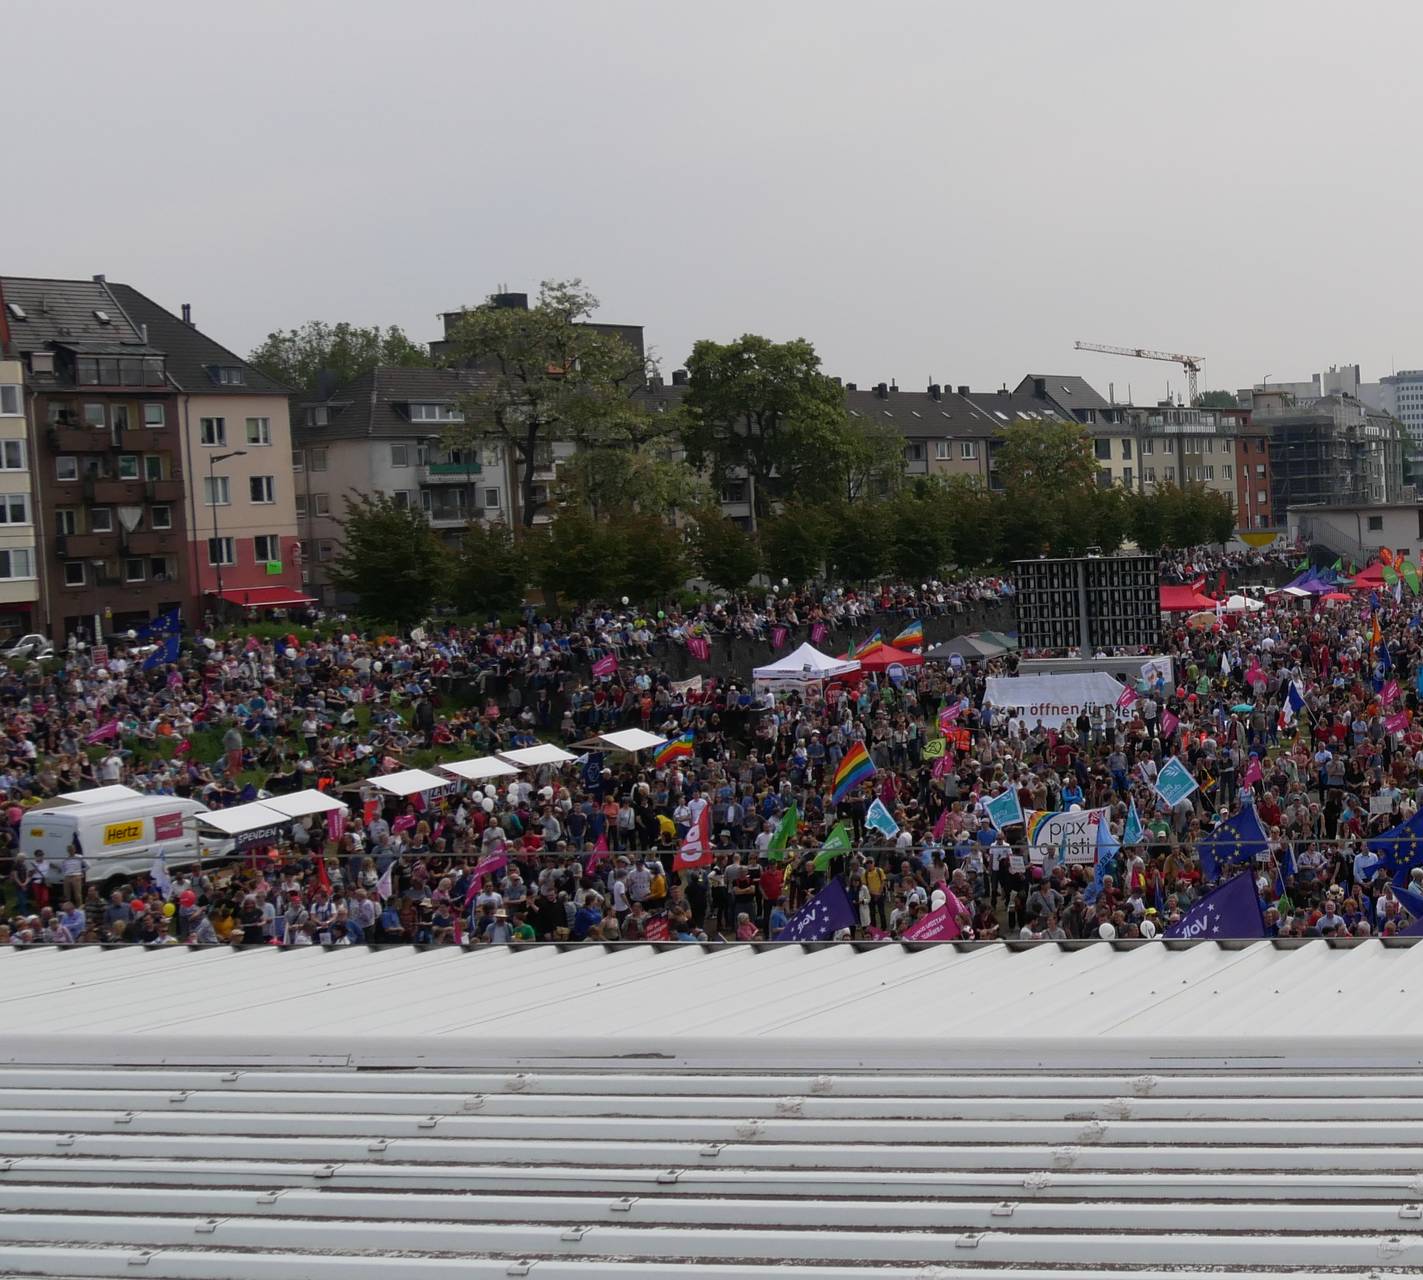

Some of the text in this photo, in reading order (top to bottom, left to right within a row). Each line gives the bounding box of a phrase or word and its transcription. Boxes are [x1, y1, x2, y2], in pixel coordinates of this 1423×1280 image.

[1029, 702, 1080, 716] öffnen
[108, 825, 138, 841] Hertz
[238, 826, 277, 844] SPENDEN
[1050, 822, 1086, 843] pax
